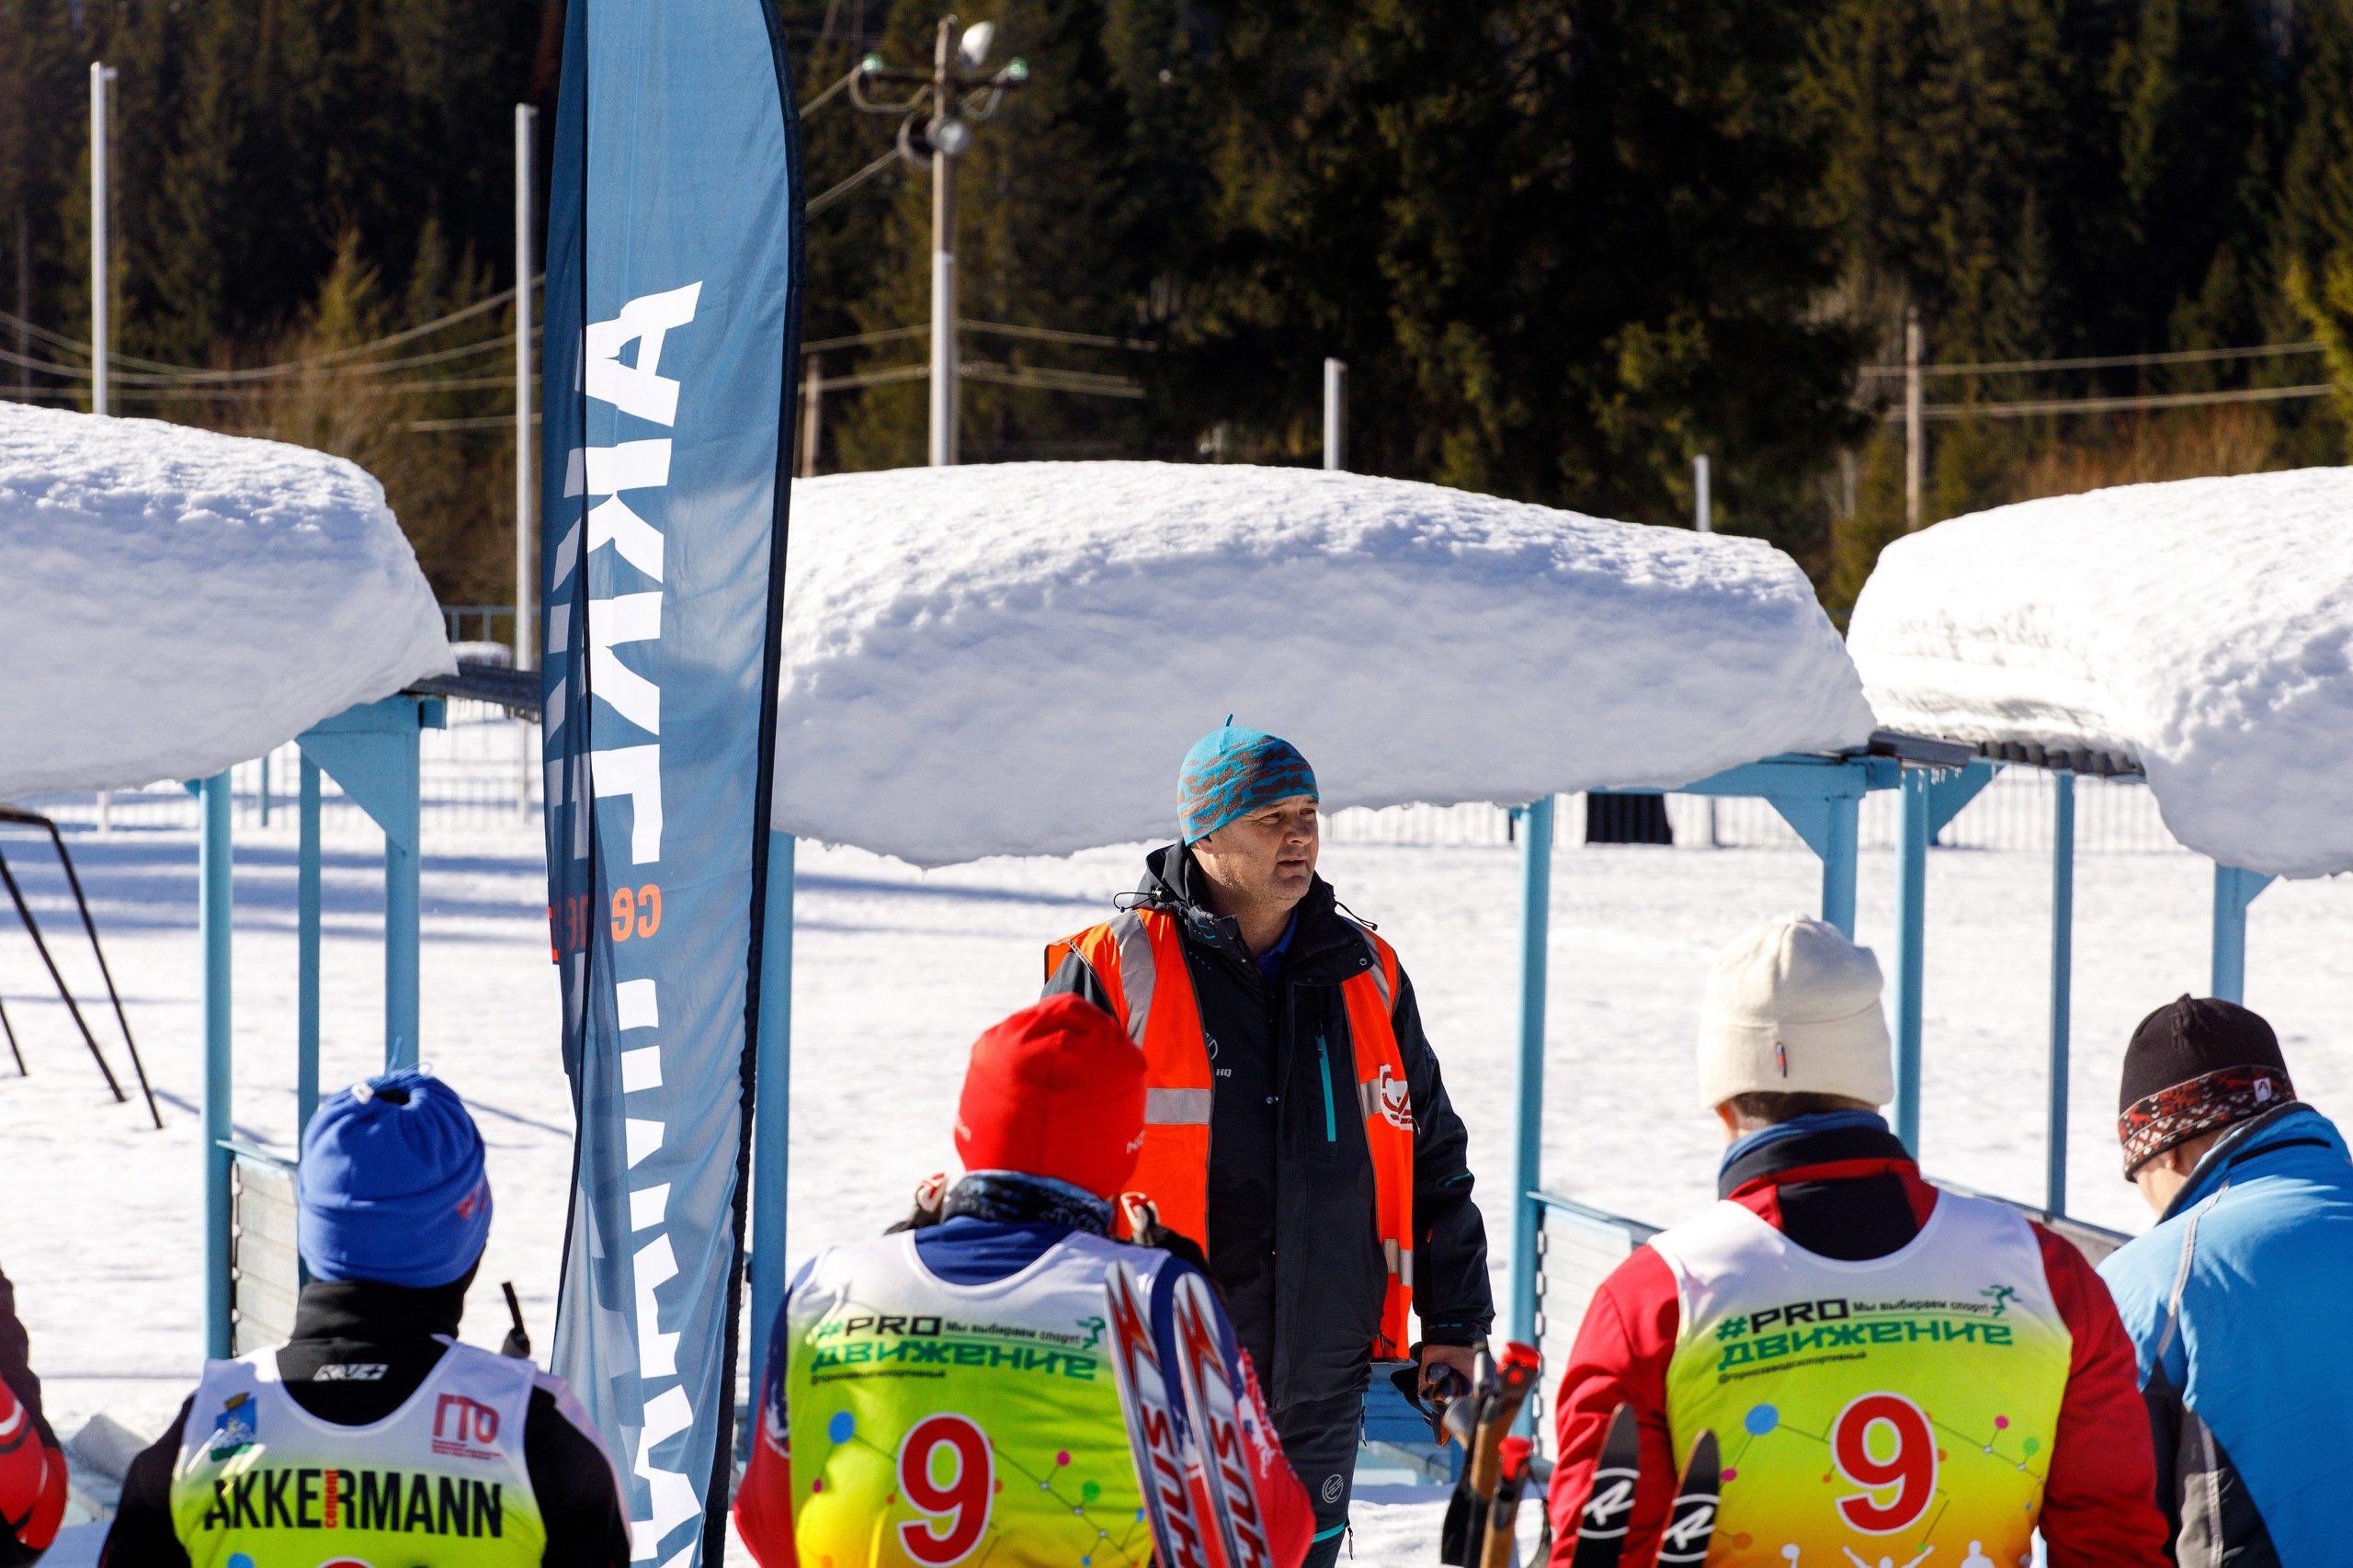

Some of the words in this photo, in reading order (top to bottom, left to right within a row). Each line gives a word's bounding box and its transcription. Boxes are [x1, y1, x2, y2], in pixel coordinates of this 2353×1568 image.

[1853, 1301, 1876, 1312] Мы
[896, 1412, 995, 1568] 9
[1830, 1391, 1939, 1536] 9
